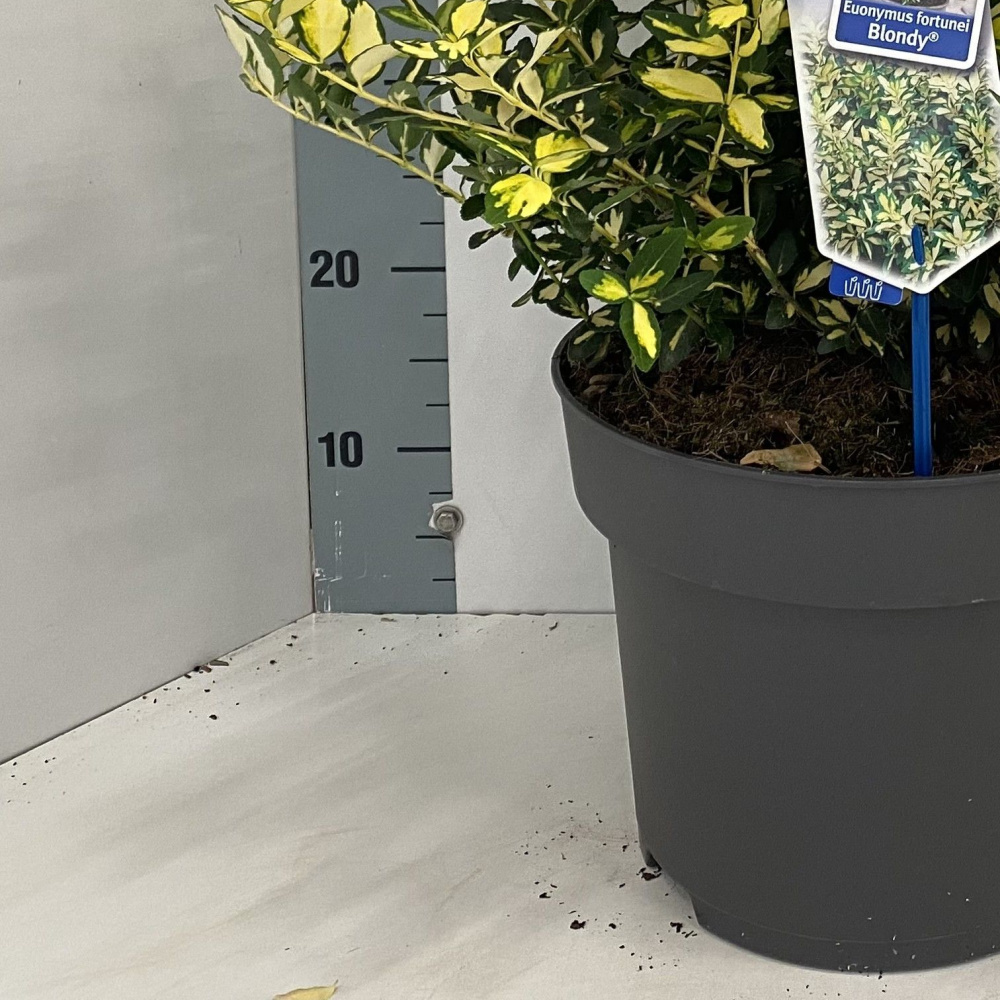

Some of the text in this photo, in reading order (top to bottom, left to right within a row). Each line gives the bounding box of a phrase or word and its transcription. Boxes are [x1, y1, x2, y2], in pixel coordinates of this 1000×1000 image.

[842, 0, 971, 33] Euonymus fortunei
[309, 249, 360, 288] 20
[317, 431, 364, 468] 10
